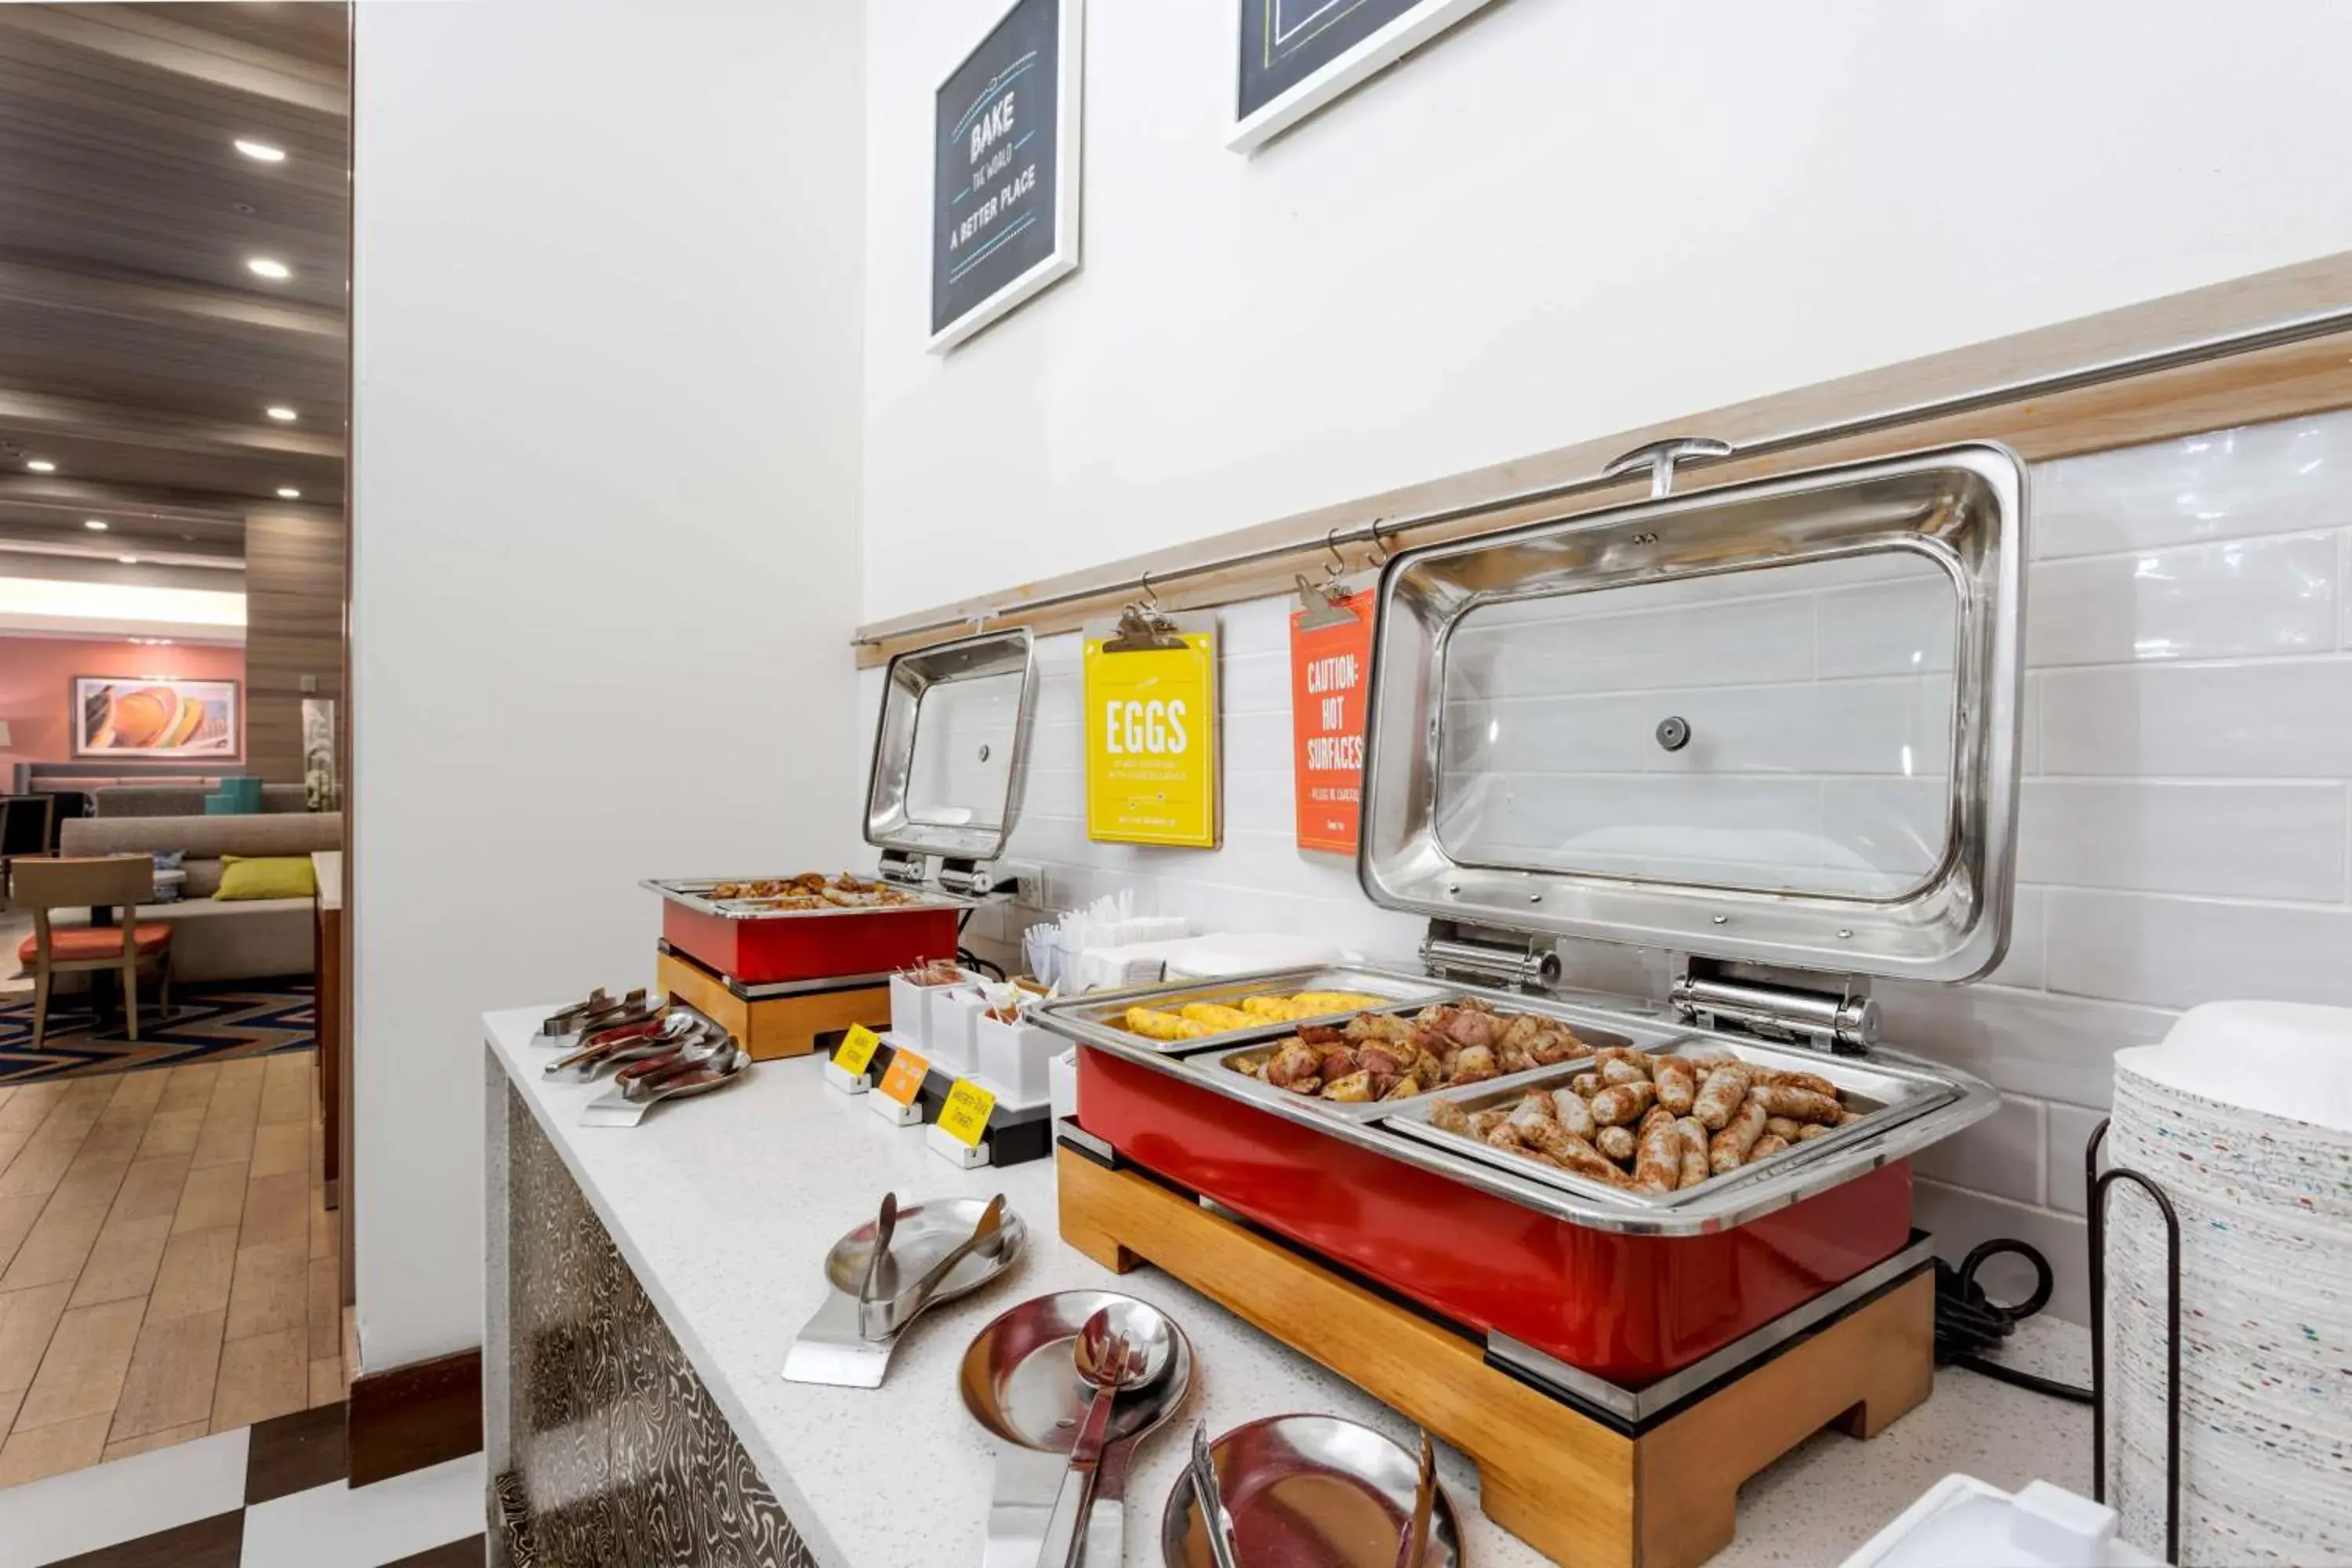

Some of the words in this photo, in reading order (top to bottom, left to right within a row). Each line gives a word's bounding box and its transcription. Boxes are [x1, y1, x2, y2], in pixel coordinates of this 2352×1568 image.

[970, 91, 1015, 165] BAKE
[973, 165, 985, 192] THE
[986, 142, 1013, 181] WORLD
[950, 230, 958, 251] A
[960, 196, 998, 244] BETTER
[1000, 163, 1036, 210] PLACE
[1307, 653, 1359, 694] CAUTION:
[1106, 699, 1188, 753] EGGS
[1322, 695, 1345, 731] HOT
[1307, 735, 1363, 770] SURFACES
